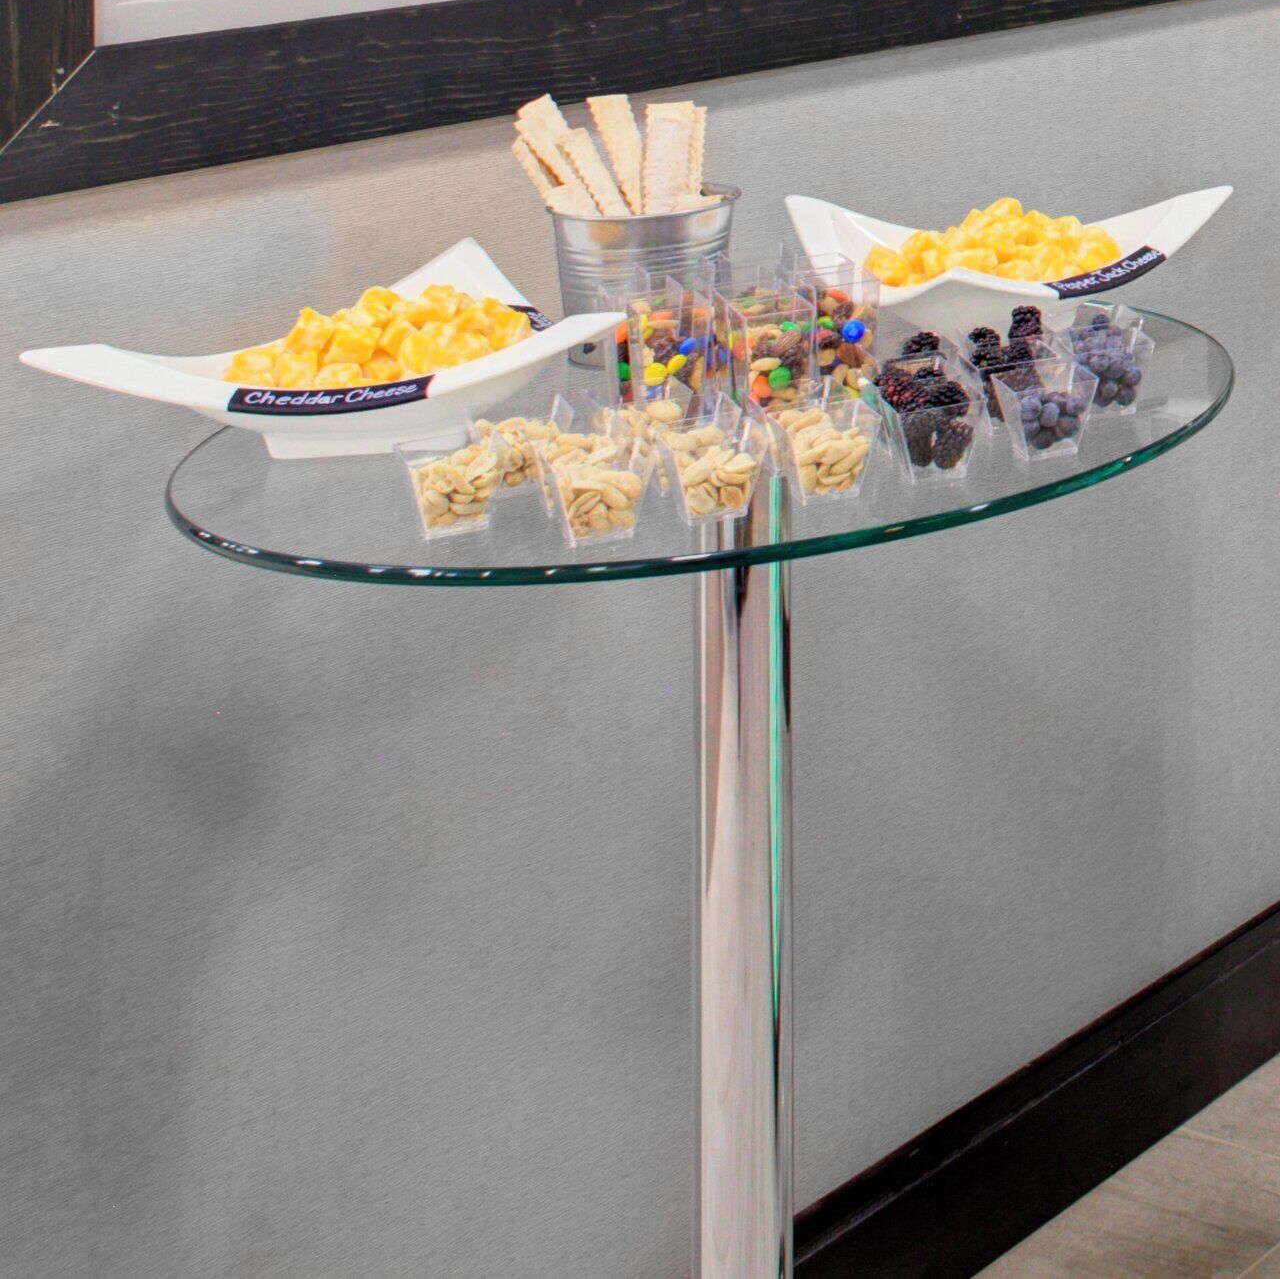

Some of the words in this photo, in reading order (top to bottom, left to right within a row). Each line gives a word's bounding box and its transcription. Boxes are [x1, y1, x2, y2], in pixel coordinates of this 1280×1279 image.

[1052, 276, 1099, 291] Pepper
[1092, 265, 1126, 283] Jack
[1124, 249, 1163, 270] Cheese
[244, 391, 343, 405] Cheddar
[345, 383, 418, 403] Cheese
